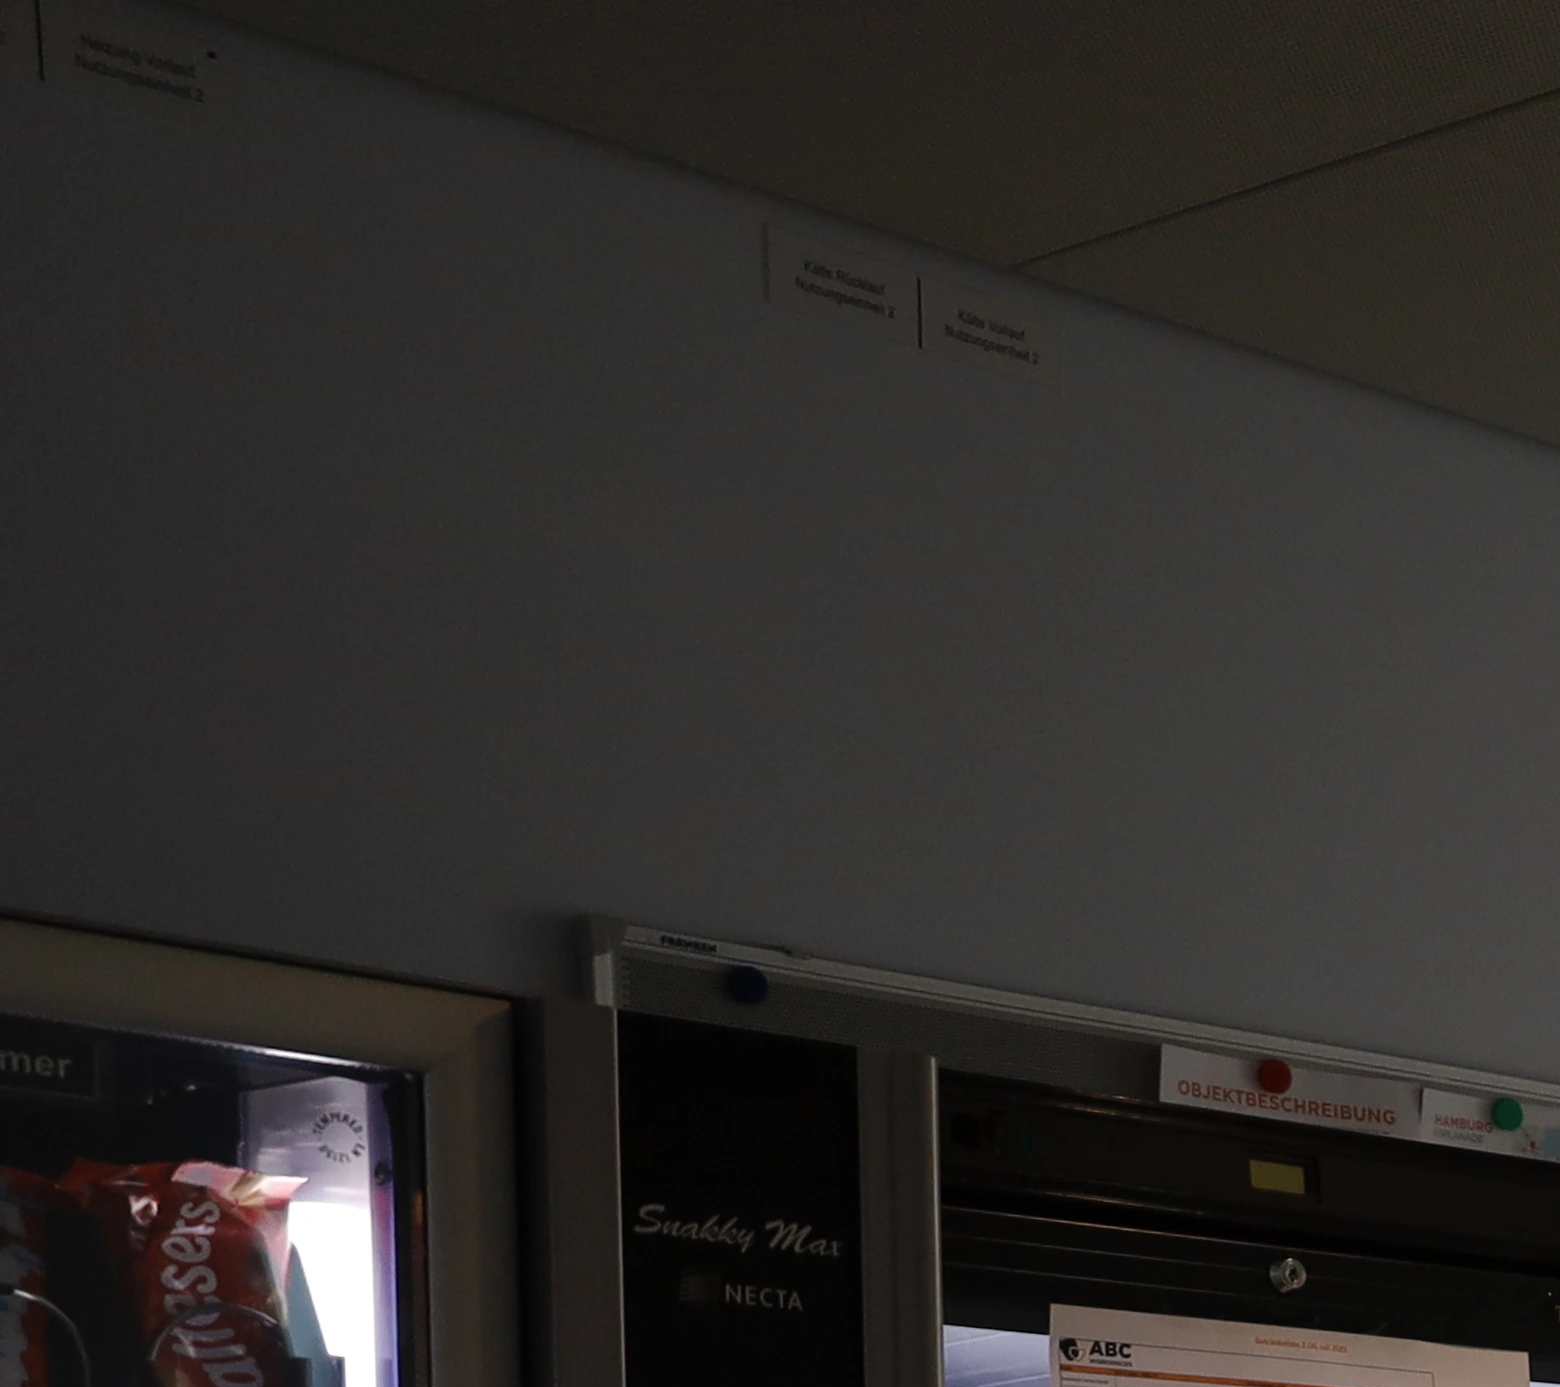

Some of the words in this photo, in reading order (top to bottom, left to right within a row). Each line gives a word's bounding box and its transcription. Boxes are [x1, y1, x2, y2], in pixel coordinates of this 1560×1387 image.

[1177, 1079, 1397, 1126] OBJEKTBESCHREIBUNG
[1434, 1113, 1494, 1134] HAMBURG
[633, 1202, 756, 1255] Snakky
[765, 1218, 847, 1259] Max
[723, 1283, 804, 1312] NECTA
[1089, 1341, 1133, 1359] ABC
